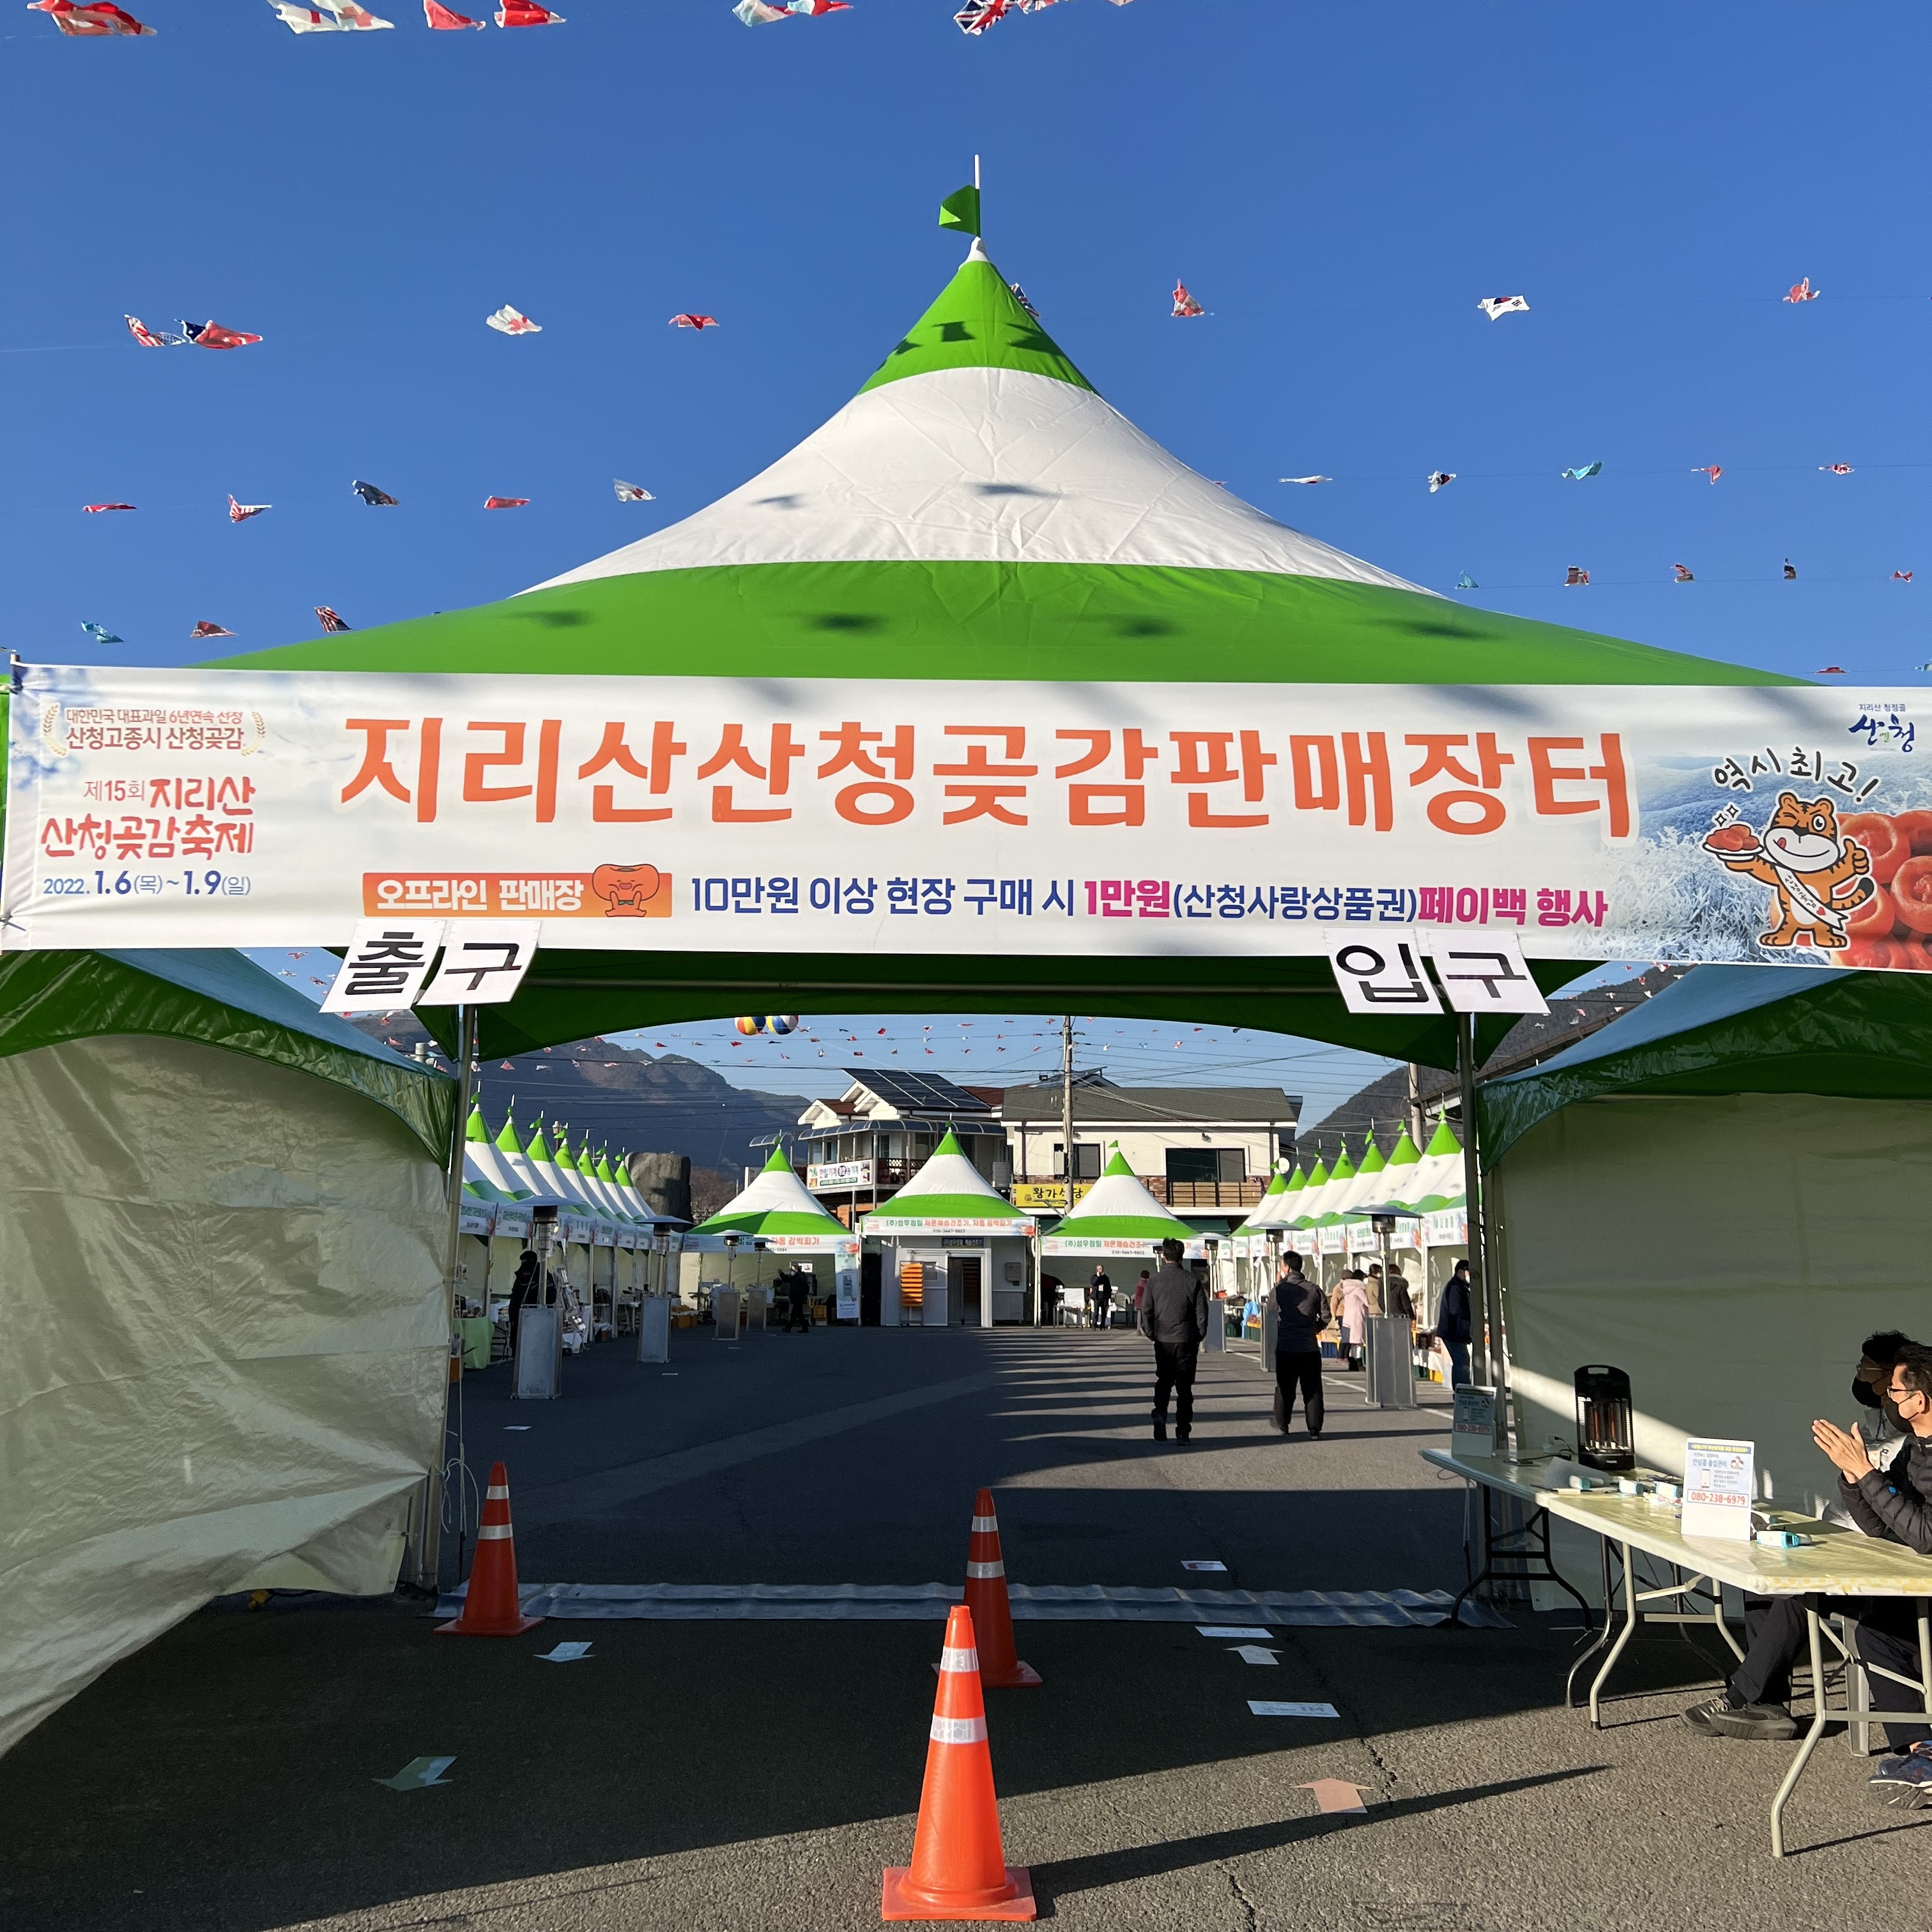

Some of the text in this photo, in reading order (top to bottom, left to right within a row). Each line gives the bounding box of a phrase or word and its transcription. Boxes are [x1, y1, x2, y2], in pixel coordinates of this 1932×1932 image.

[66, 709, 243, 724] 대한민국 대표과일 6년연속 선정
[1859, 703, 1882, 712] 지리산
[66, 726, 244, 751] 산청고종시 산청곶감
[84, 776, 257, 816] 제15회 지리산
[41, 813, 254, 861] 산청곶감축제
[377, 879, 584, 912] 오프라인 판매장
[691, 877, 799, 914] 10만원
[809, 878, 878, 915] 이상
[886, 877, 956, 916] 현장
[964, 878, 1033, 917] 구매
[1041, 879, 1074, 917] 시
[1537, 891, 1608, 927] 행사
[344, 931, 523, 995] 출구
[1336, 942, 1528, 1004] 입구
[1691, 1491, 1745, 1505] 080-238-6979
